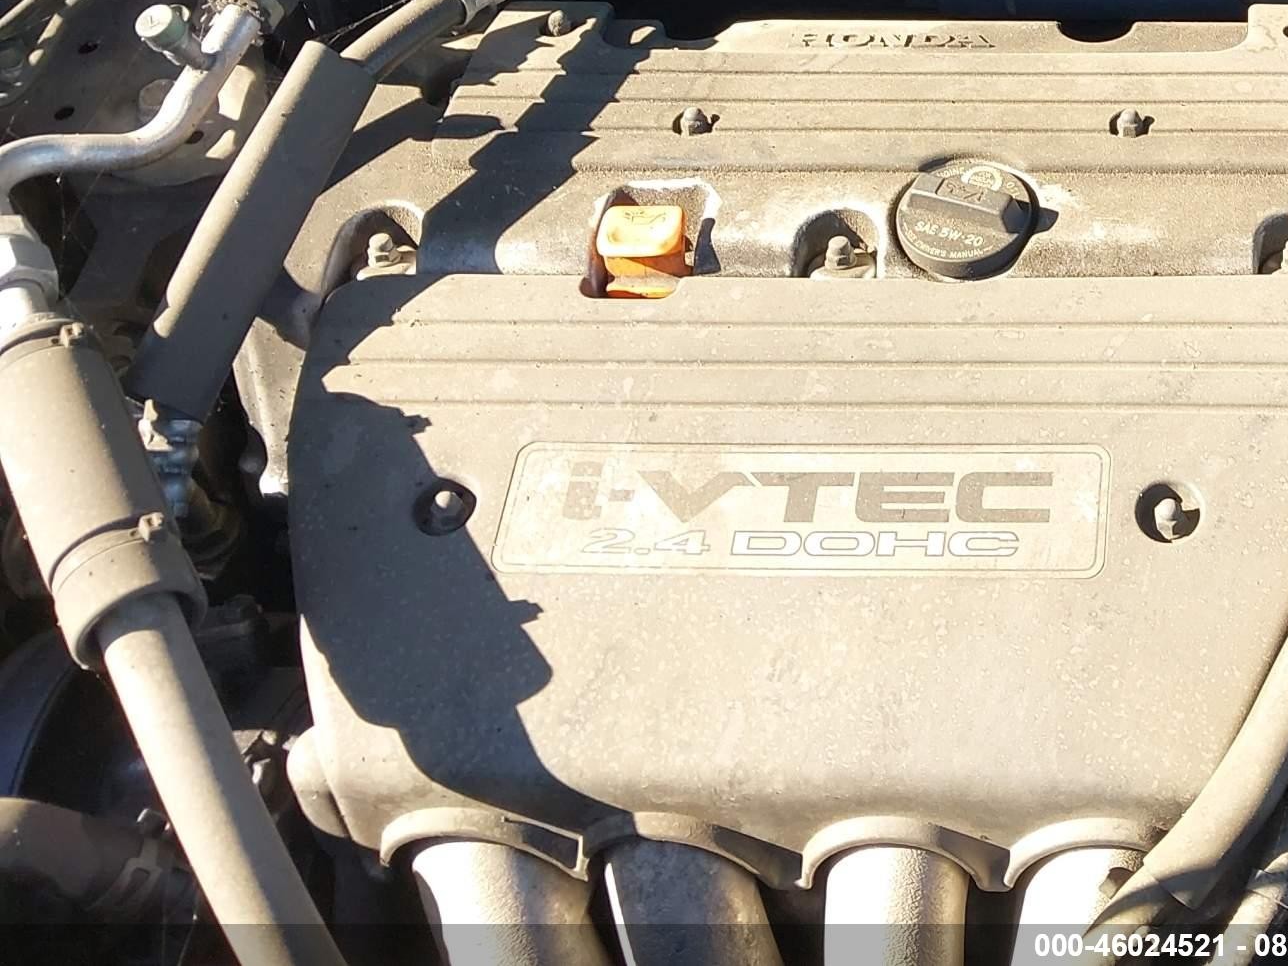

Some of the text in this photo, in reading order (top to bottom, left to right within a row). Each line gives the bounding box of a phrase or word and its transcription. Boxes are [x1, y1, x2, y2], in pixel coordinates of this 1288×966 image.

[792, 33, 996, 48] HONDA
[914, 220, 940, 235] SAE
[949, 247, 984, 259] MANUAL
[562, 461, 1054, 524] i-VTEC
[581, 527, 1020, 557] 2.4 DOHC
